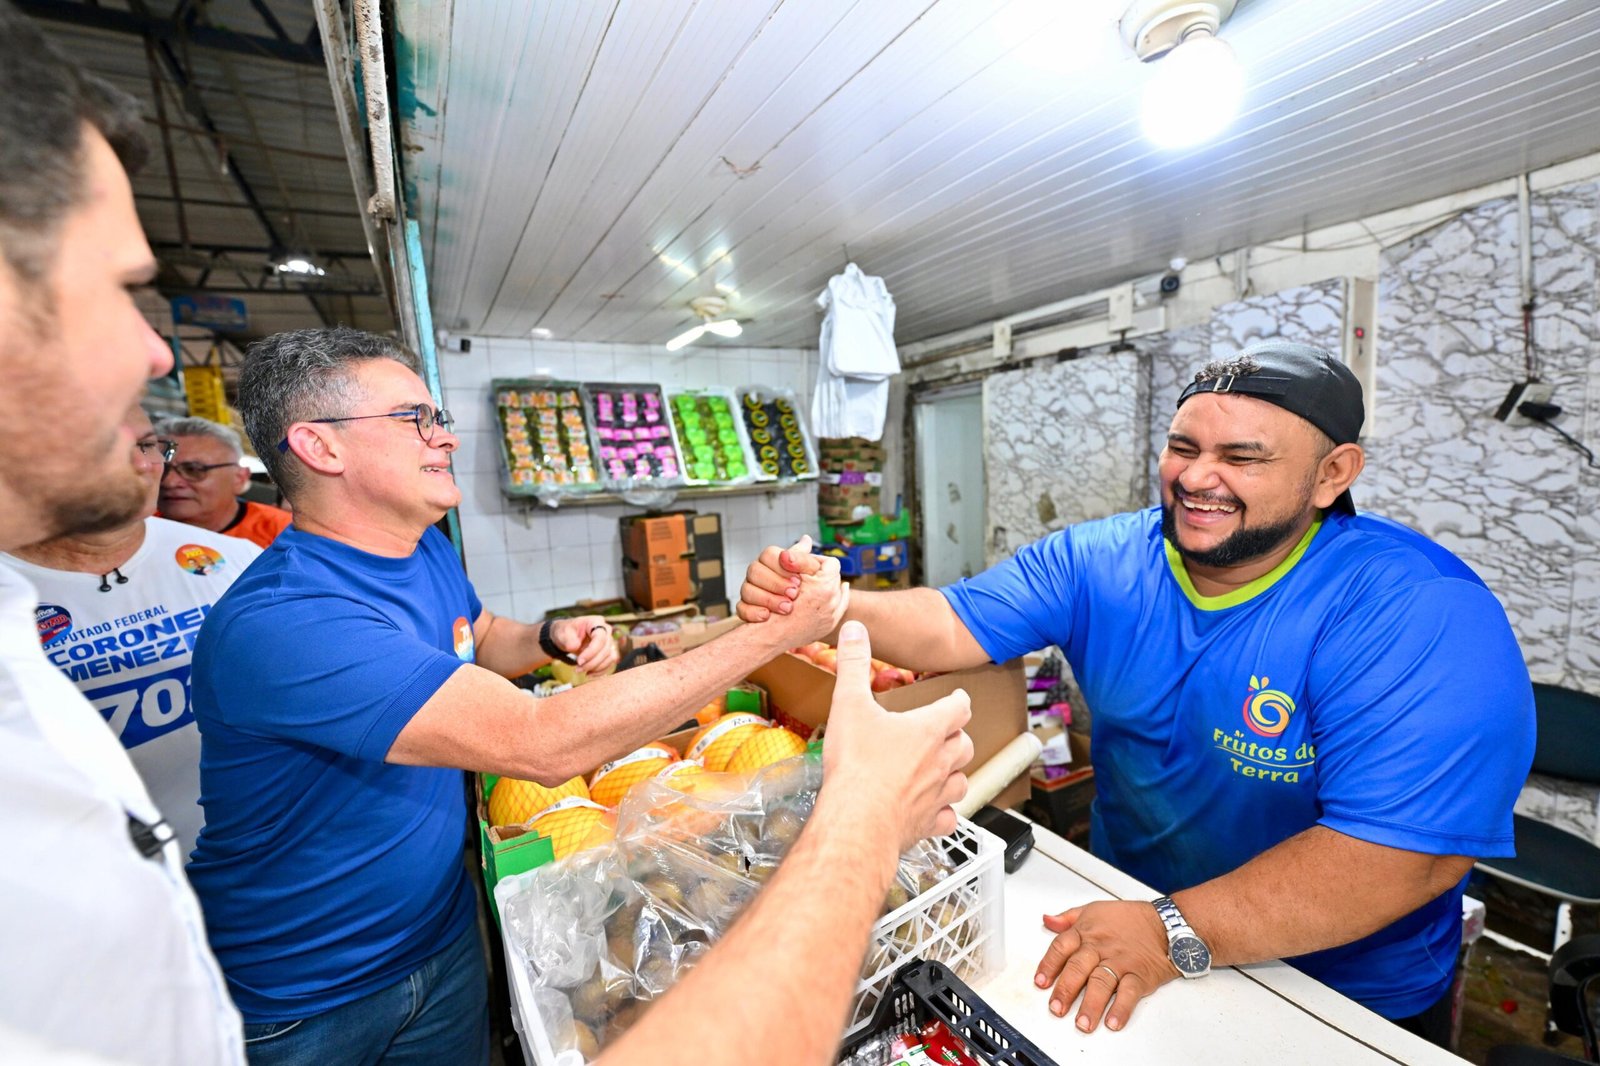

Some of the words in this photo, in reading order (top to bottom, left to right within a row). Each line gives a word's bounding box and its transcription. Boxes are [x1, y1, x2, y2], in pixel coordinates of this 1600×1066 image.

[114, 604, 169, 629] FEDERAL
[89, 677, 193, 739] 70
[1212, 727, 1288, 762] Frutos
[1230, 757, 1299, 784] Terra
